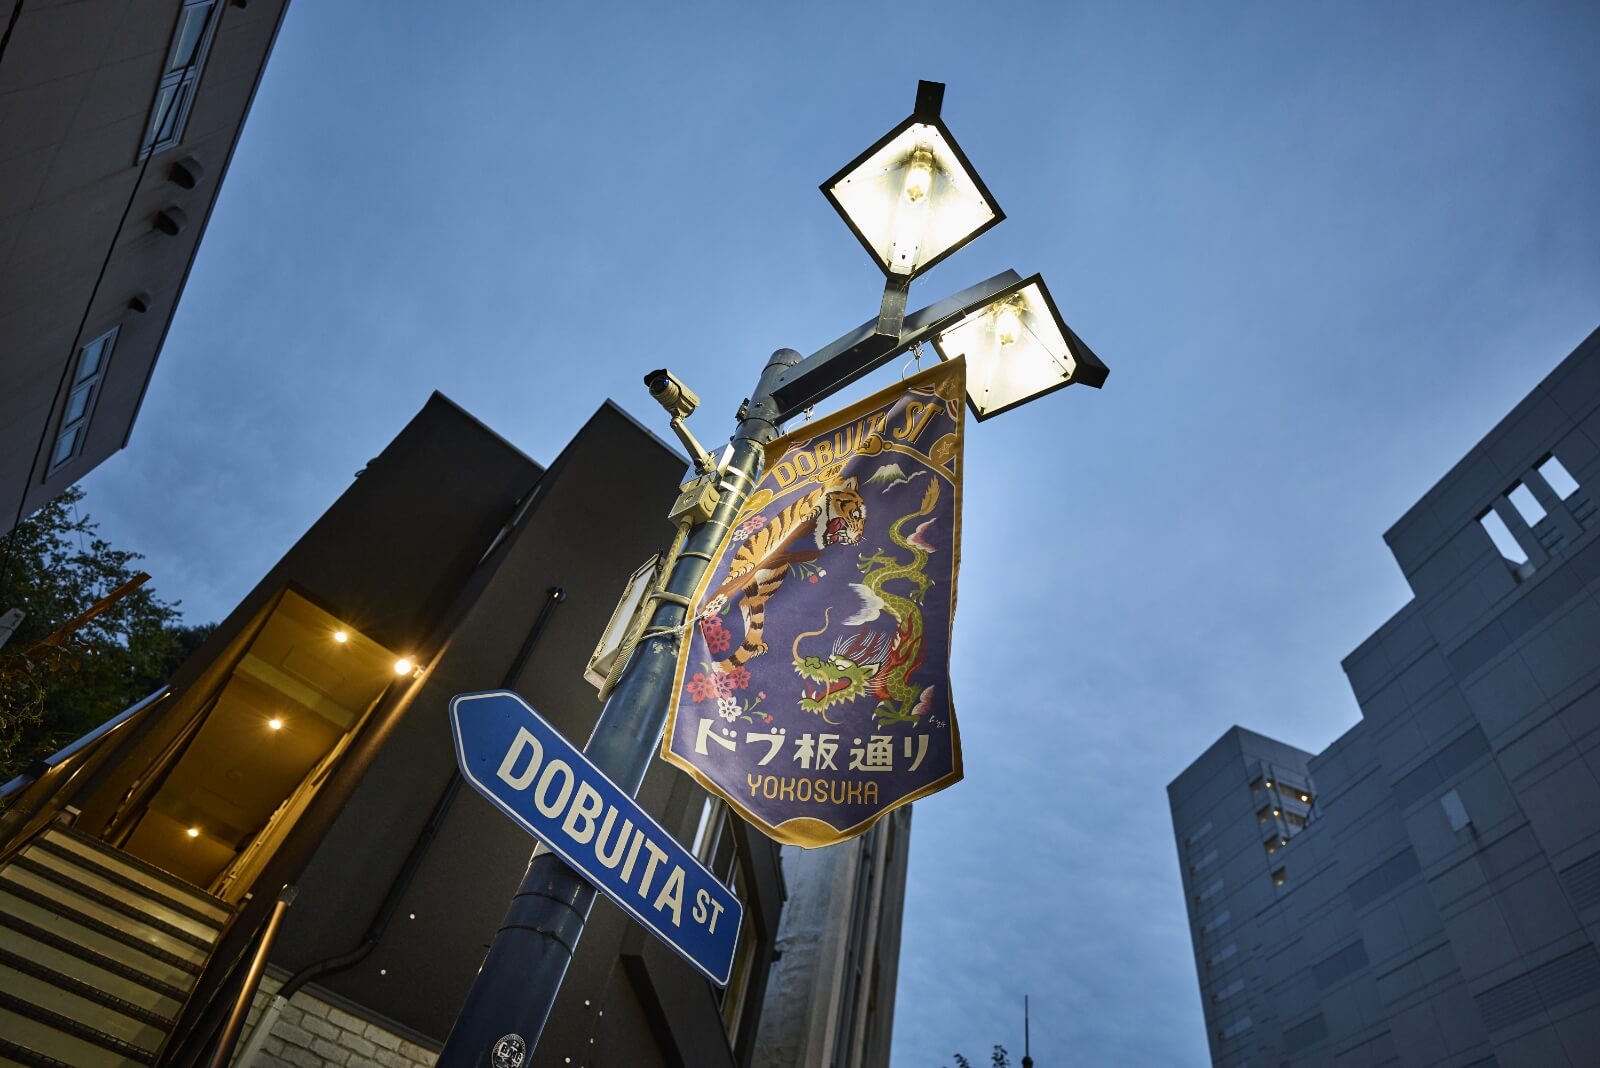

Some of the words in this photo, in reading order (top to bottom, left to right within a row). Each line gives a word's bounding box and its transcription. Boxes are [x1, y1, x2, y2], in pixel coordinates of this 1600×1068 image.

[893, 401, 947, 444] ST
[695, 719, 929, 772] ドブ板通り
[747, 773, 879, 804] YOKOSUKA
[496, 726, 686, 928] DOBUITA
[692, 888, 725, 934] ST
